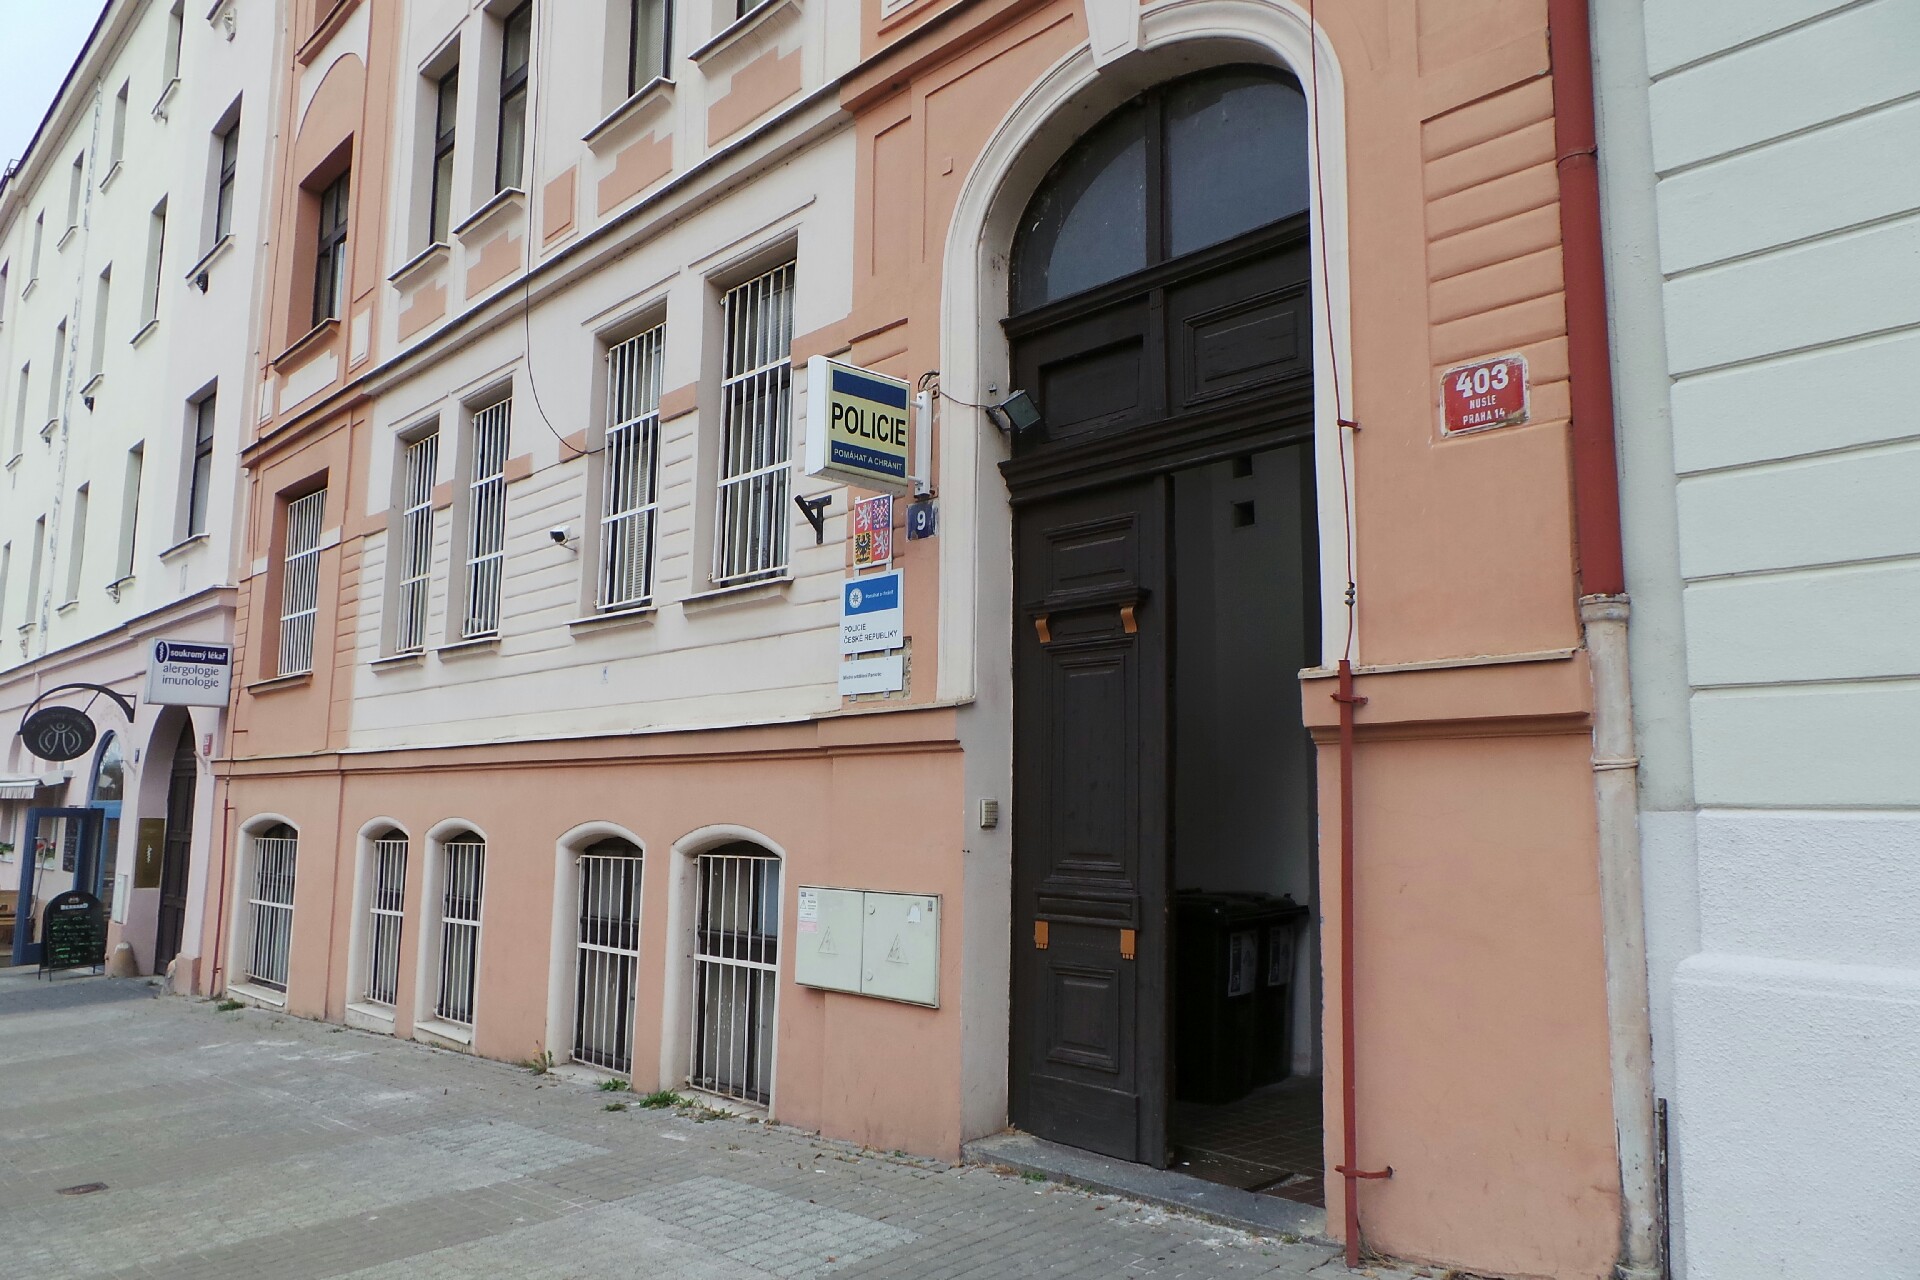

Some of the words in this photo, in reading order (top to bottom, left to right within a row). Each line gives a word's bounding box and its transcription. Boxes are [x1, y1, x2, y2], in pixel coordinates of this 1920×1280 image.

[1456, 363, 1509, 398] 403
[1469, 395, 1497, 409] NUSLE
[1463, 410, 1492, 425] PRAHA
[1494, 407, 1506, 419] 14
[831, 402, 906, 447] POLICIE
[834, 448, 867, 463] POMÁHAT
[874, 457, 903, 471] CHRÁNIT
[917, 510, 926, 531] 9
[844, 623, 866, 633] POLICIE
[865, 630, 897, 640] REPUBLIKY
[170, 649, 207, 661] soukromý
[163, 663, 219, 678] alergologie
[162, 675, 219, 689] imunologie
